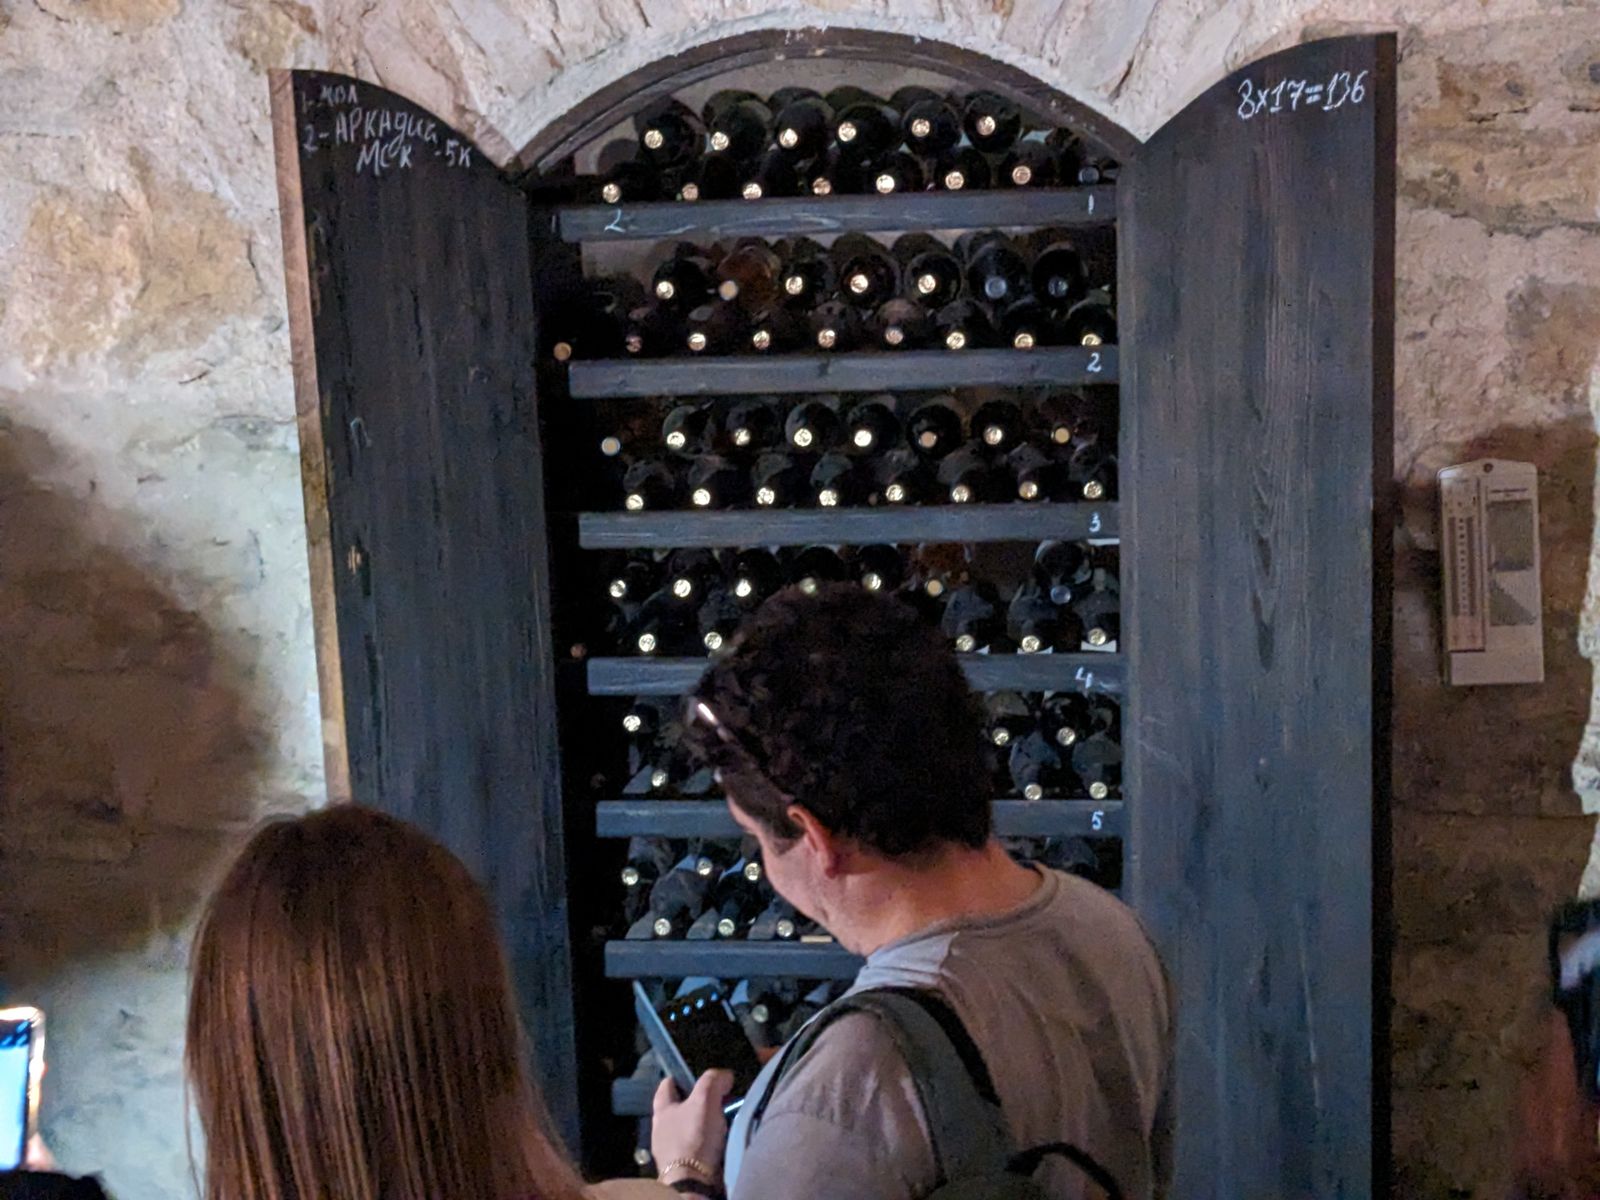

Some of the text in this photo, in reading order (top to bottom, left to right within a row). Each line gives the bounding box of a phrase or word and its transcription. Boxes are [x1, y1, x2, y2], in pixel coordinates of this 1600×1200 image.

[1086, 352, 1102, 373] 2
[1089, 511, 1101, 532] 3
[1075, 666, 1093, 689] 4
[1091, 810, 1104, 830] 5
